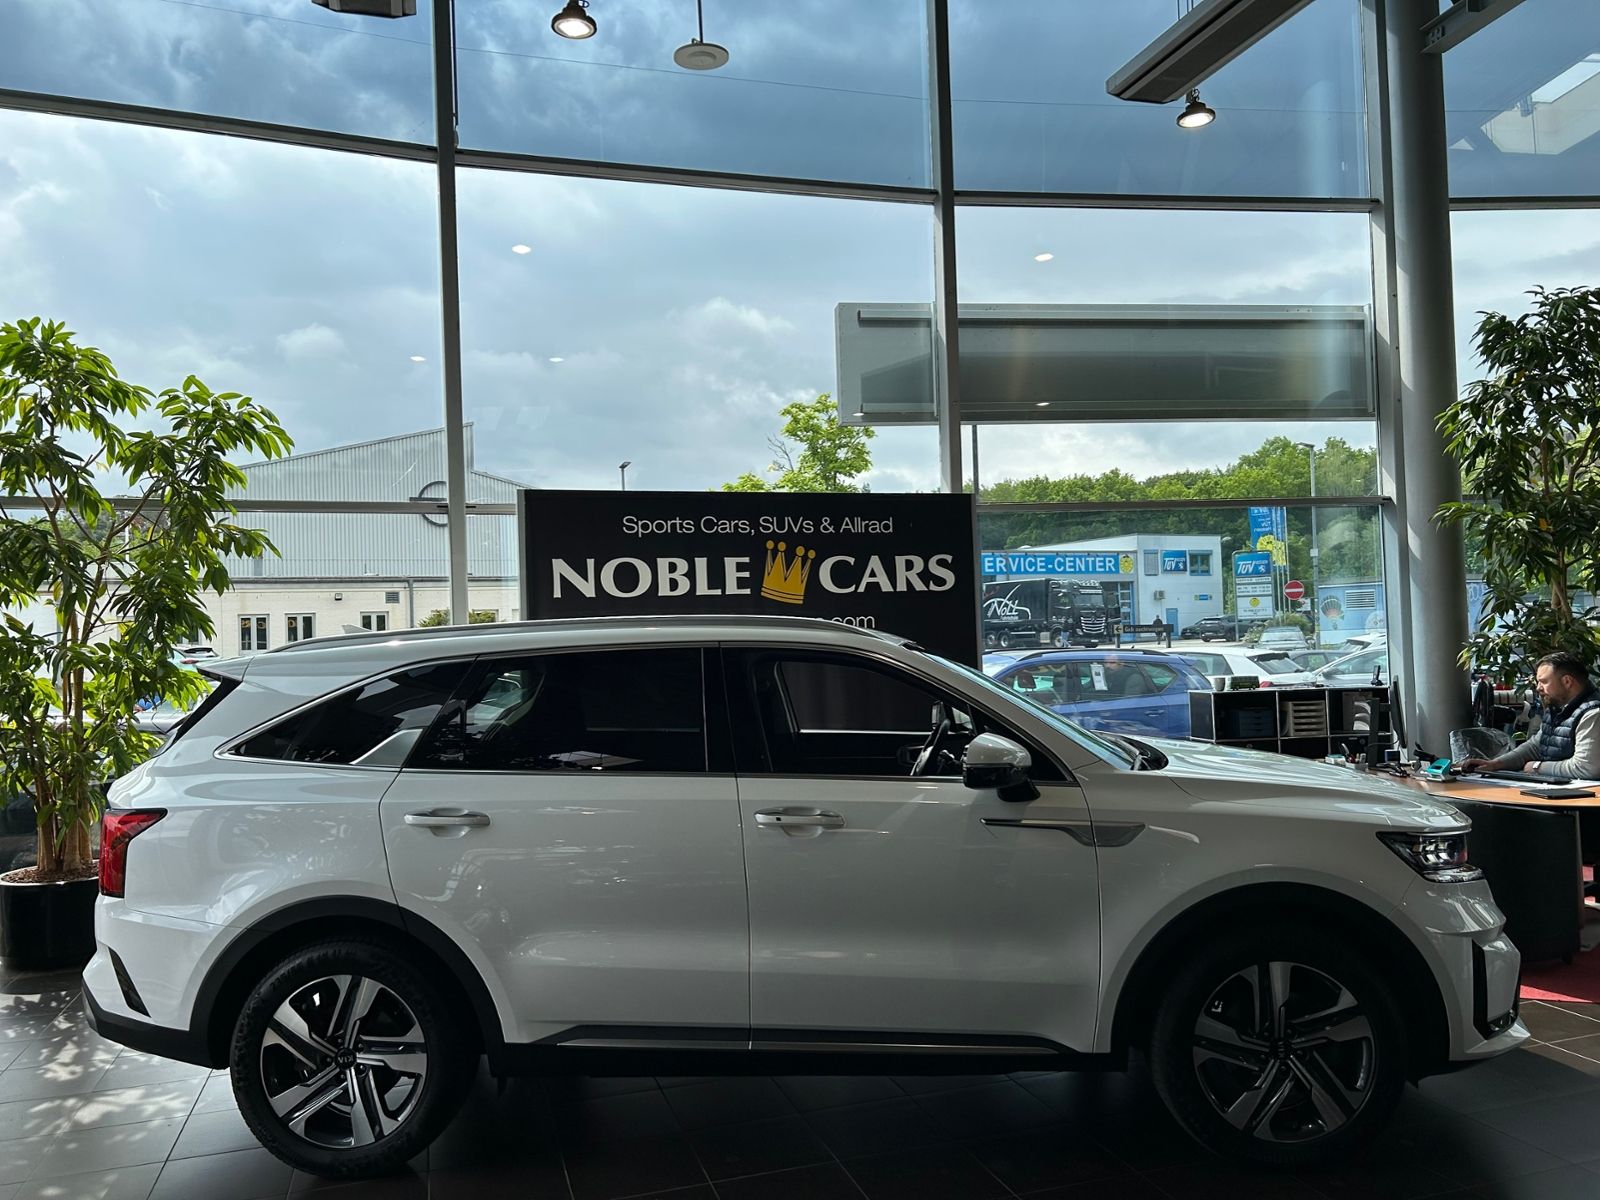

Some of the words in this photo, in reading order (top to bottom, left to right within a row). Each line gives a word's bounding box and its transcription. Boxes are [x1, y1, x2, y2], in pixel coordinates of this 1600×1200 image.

[622, 515, 695, 538] Sports
[700, 515, 755, 536] Cars,
[759, 516, 815, 533] SUVs
[820, 516, 836, 533] &
[840, 516, 894, 533] Allrad
[551, 556, 751, 599] NOBLE
[818, 553, 956, 594] CARS
[983, 556, 1116, 573] ERVICE-CENTER
